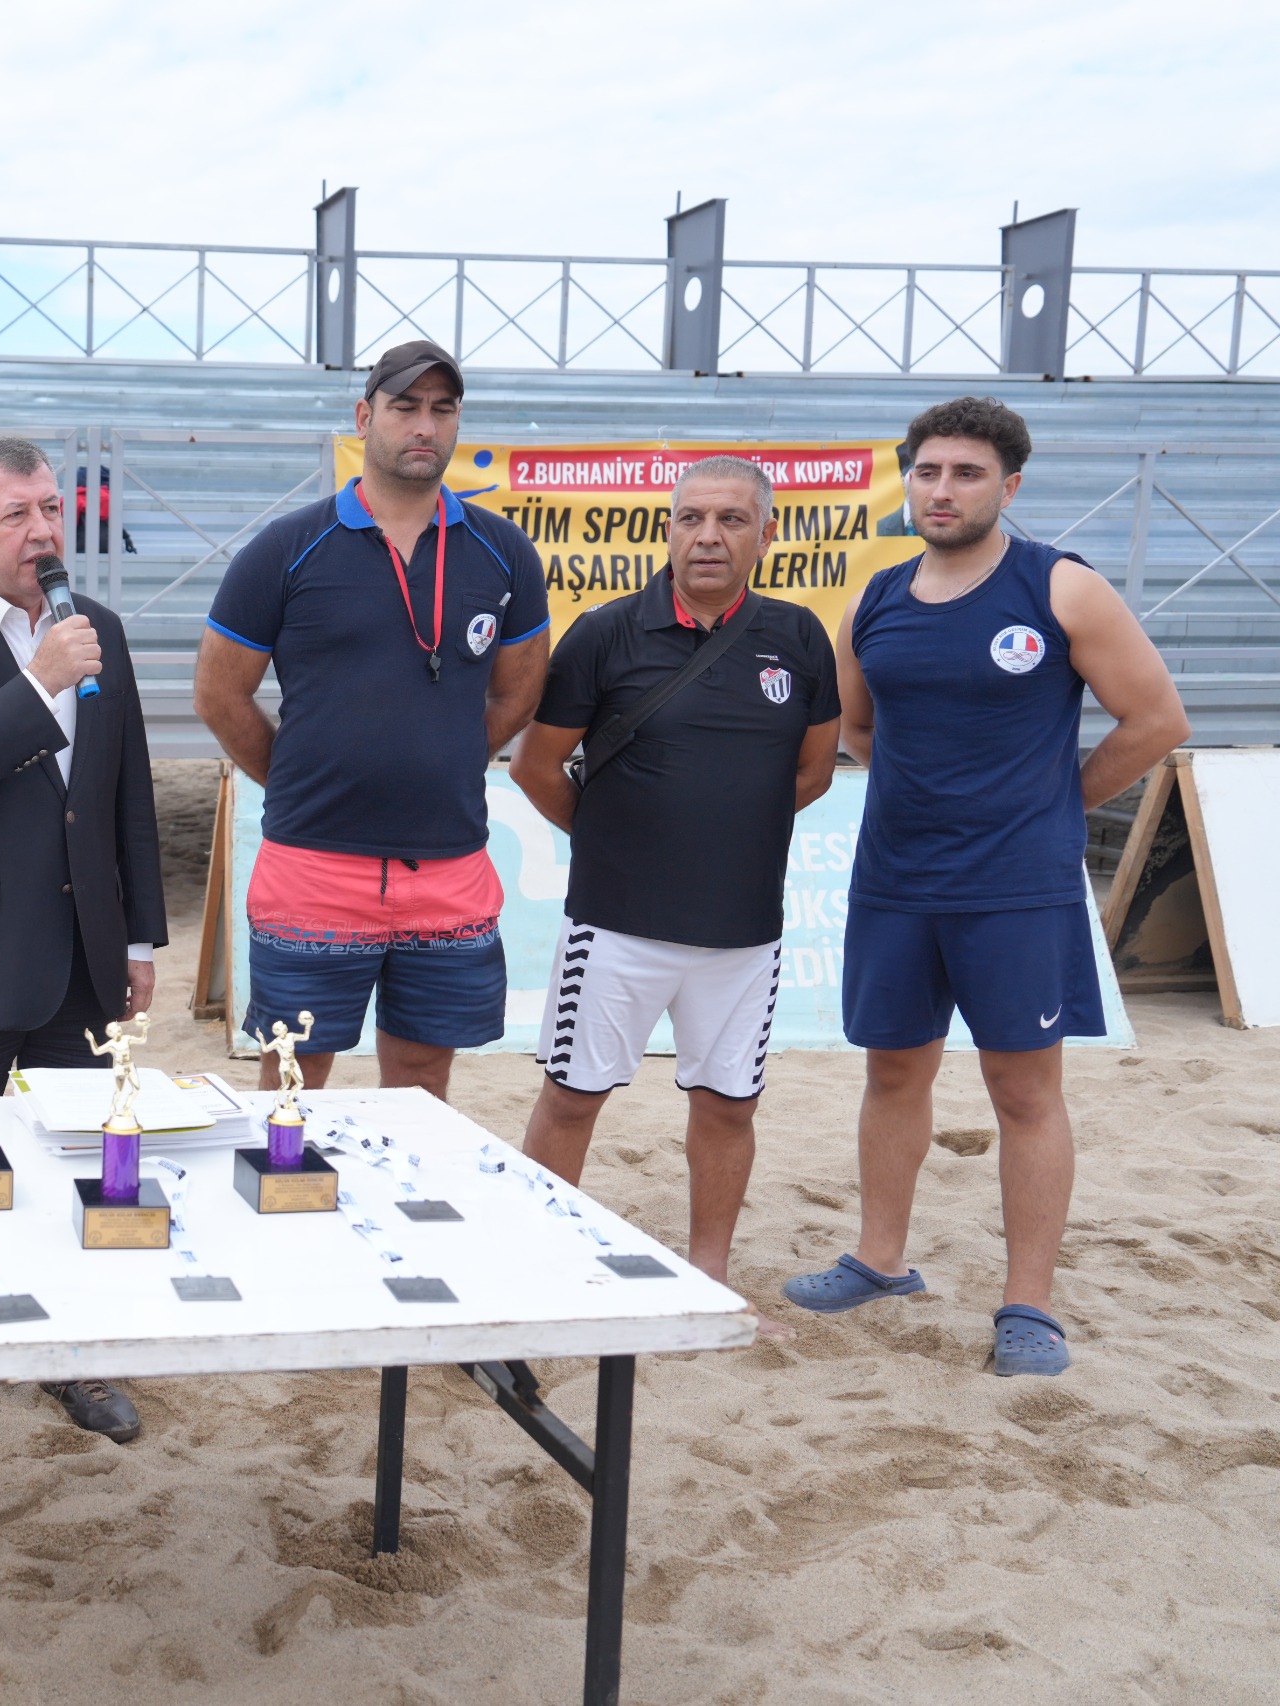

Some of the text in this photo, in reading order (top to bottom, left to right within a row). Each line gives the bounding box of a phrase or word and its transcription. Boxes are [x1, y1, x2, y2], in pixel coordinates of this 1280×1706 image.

[517, 456, 645, 485] 2.BURHANİYE
[651, 456, 693, 485] ÖRE
[794, 460, 862, 483] KUPASI
[502, 497, 572, 543] TÜM
